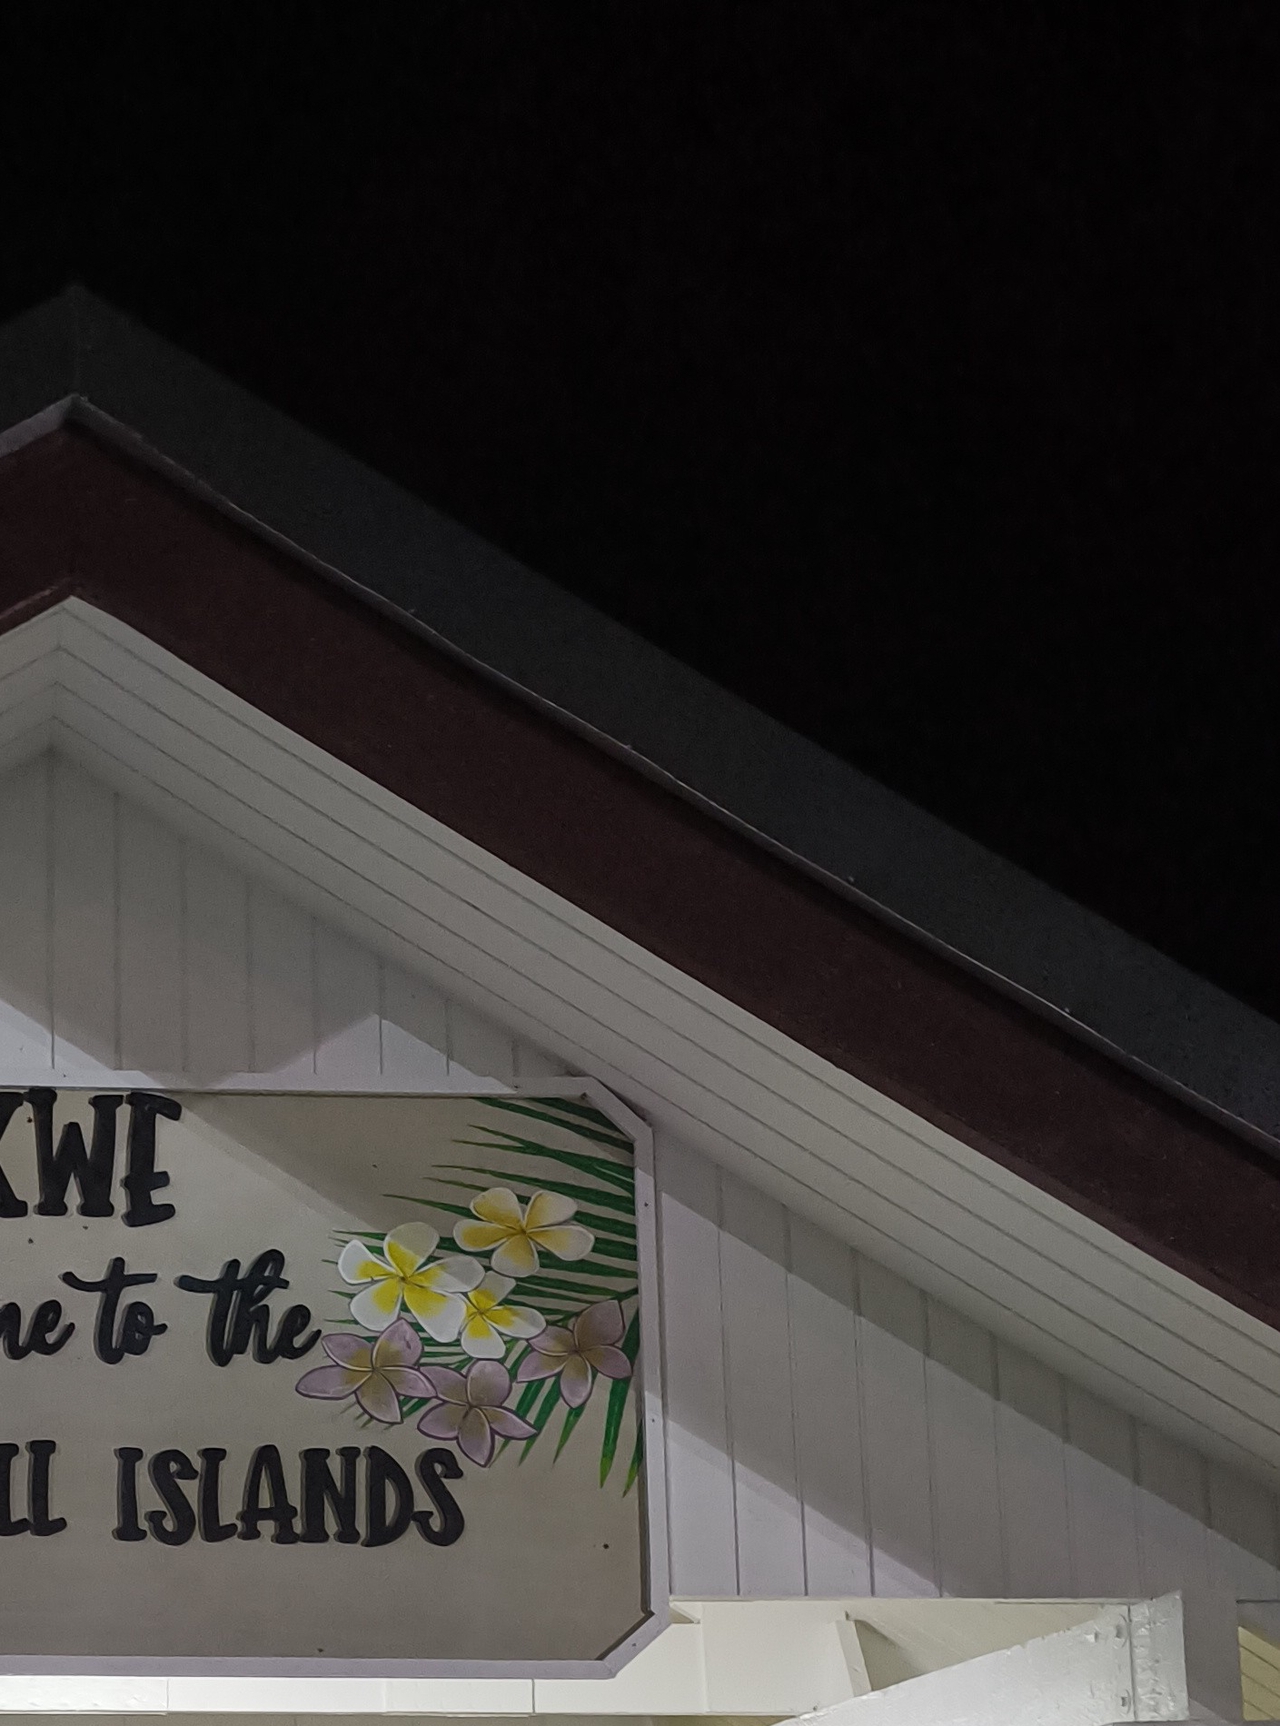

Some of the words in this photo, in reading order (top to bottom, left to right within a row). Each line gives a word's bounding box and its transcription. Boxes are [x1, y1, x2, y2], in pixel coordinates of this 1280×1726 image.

[60, 1256, 168, 1365] to
[176, 1248, 321, 1367] the
[112, 1444, 466, 1548] ISLANDS
